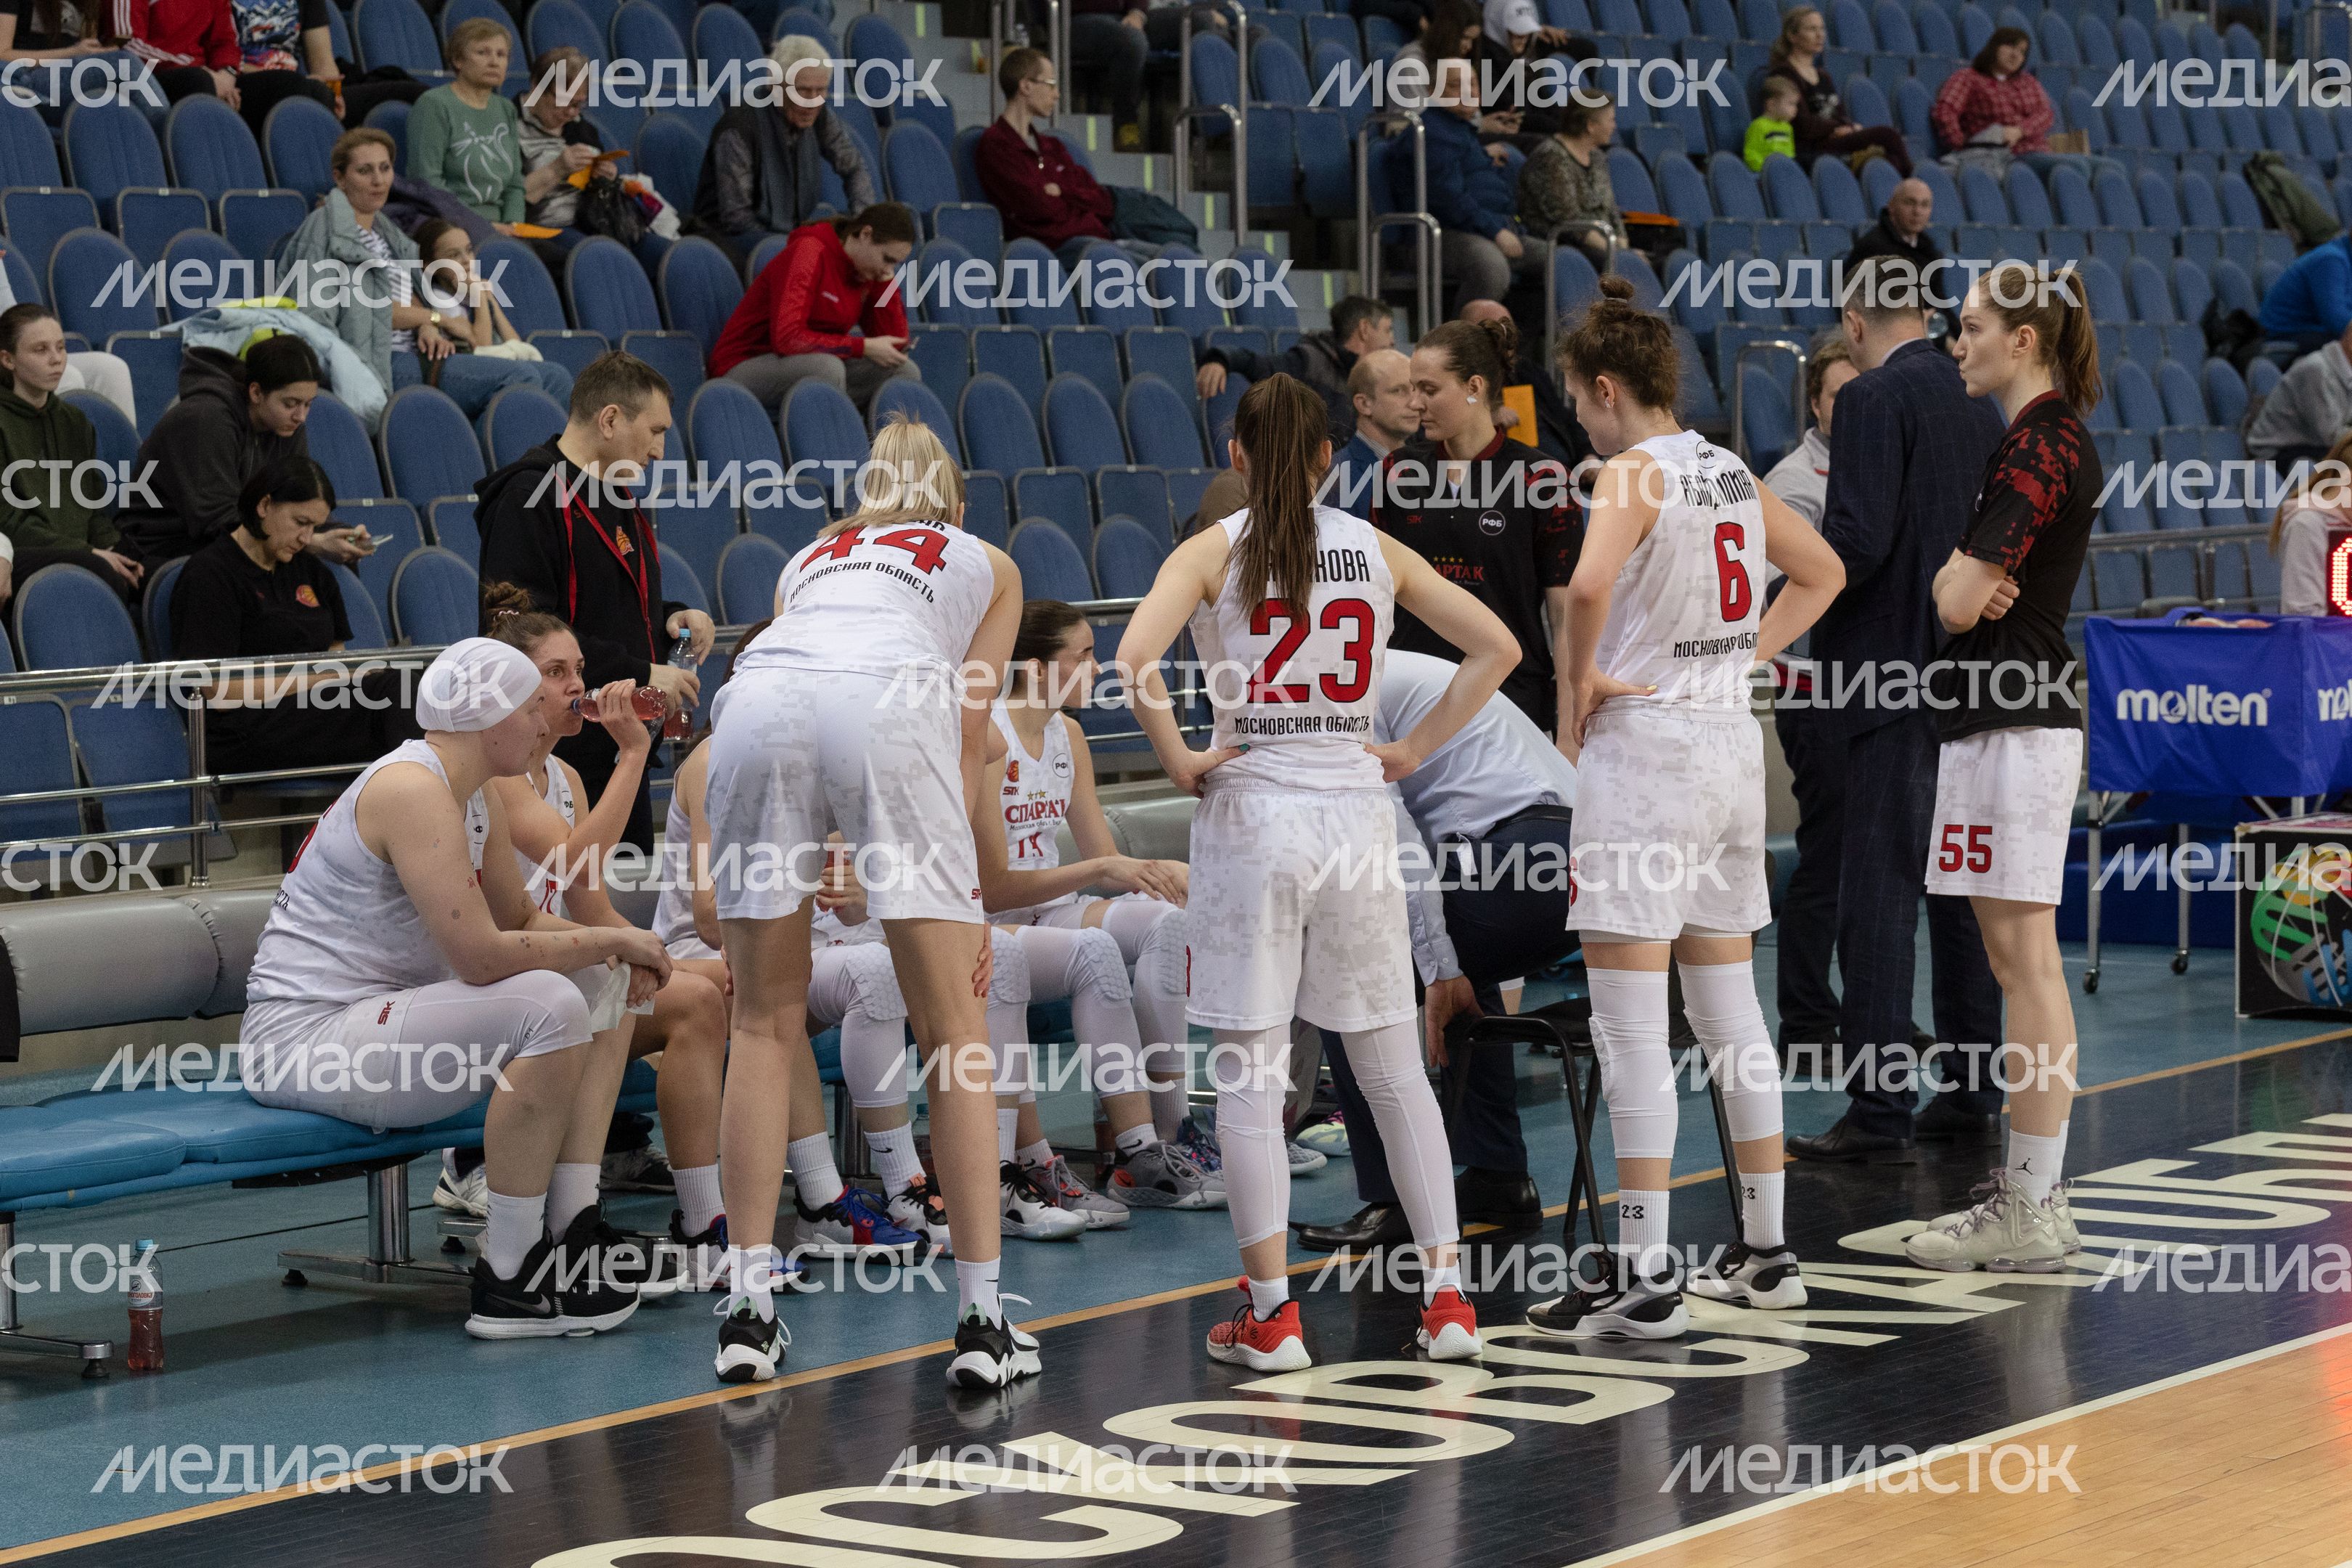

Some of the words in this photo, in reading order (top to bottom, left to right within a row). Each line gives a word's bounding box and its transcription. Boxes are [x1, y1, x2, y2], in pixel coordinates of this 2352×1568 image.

[1482, 518, 1503, 528] РФБ
[799, 526, 950, 576] 44
[1714, 520, 1752, 623] 6
[875, 562, 934, 603] ОБЛАСТЬ
[1246, 597, 1376, 704] 23
[1234, 716, 1321, 735] МОСКОВСКАЯ
[2116, 684, 2269, 726] molten
[1055, 761, 1069, 770] РФ
[1938, 824, 1993, 873] 55
[377, 1000, 396, 1026] STK
[1621, 1204, 1645, 1220] 23
